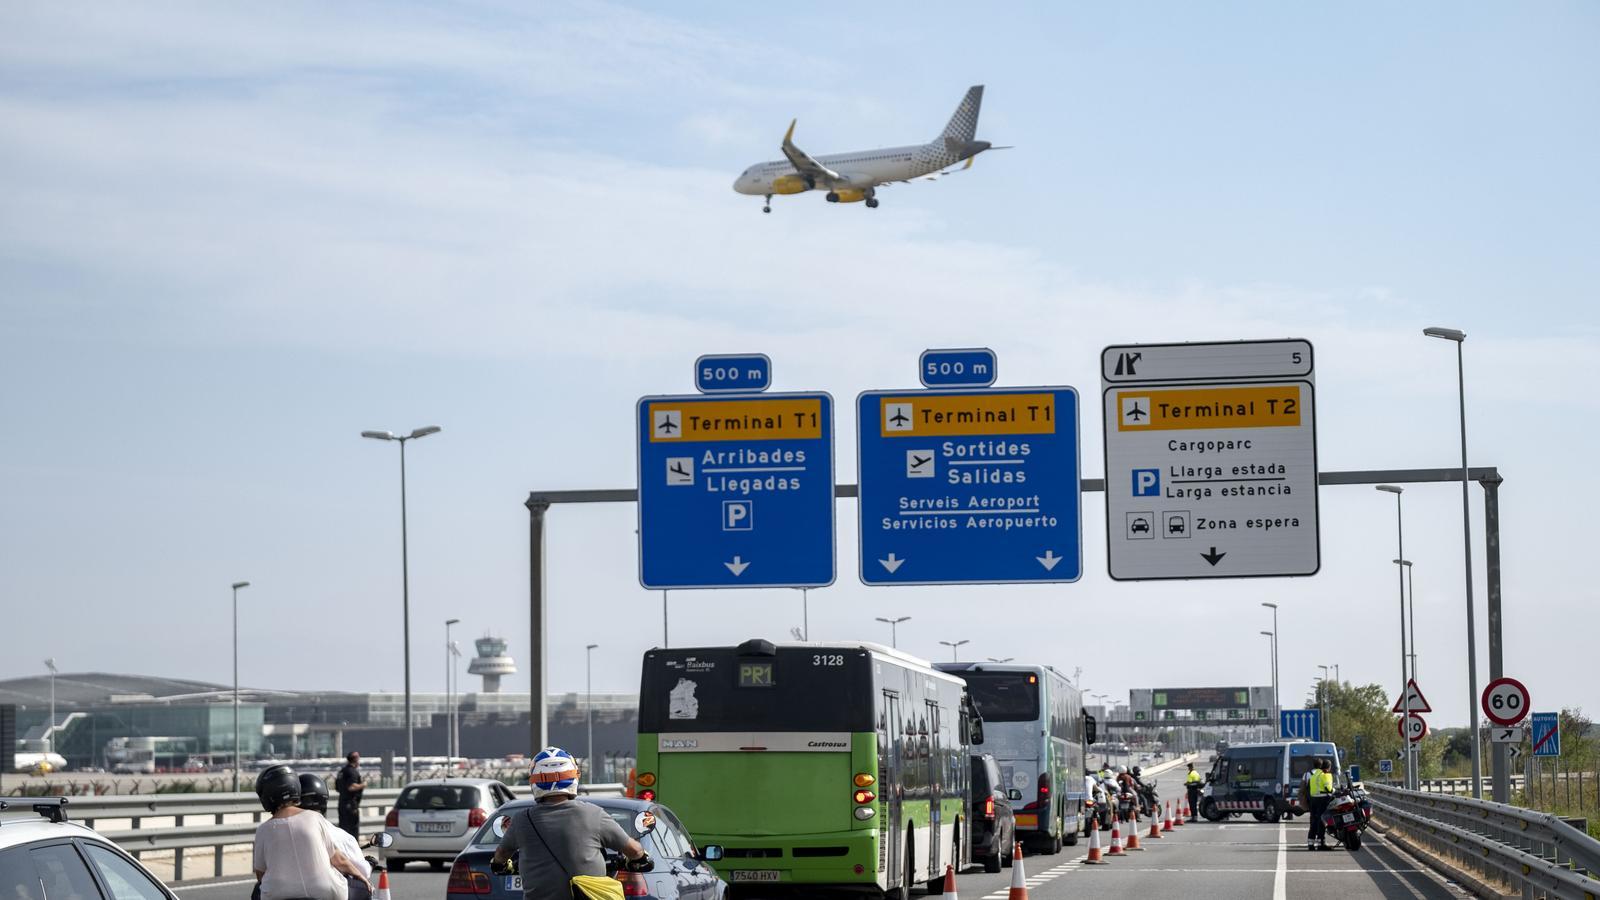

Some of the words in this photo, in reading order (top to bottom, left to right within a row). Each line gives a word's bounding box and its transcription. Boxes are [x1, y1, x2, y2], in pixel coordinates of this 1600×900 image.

[1292, 352, 1302, 364] 5
[703, 367, 739, 381] 500
[748, 368, 762, 380] m
[927, 362, 964, 375] 500
[973, 363, 987, 374] m
[921, 407, 1016, 424] Terminal
[1027, 405, 1051, 422] T1
[1159, 401, 1255, 418] Terminal
[1267, 399, 1297, 415] T2
[690, 414, 783, 431] Terminal
[794, 412, 817, 428] T1
[942, 441, 1031, 457] Sortides
[1168, 438, 1252, 453] Cargoparc
[702, 449, 806, 465] Arribades
[948, 468, 1026, 484] Salidas
[1170, 465, 1222, 479] Llarga
[1232, 463, 1286, 476] estada
[707, 475, 801, 495] Llegadas
[1137, 471, 1156, 495] P
[1166, 486, 1212, 500] Larga
[1221, 483, 1291, 497] estancia
[899, 496, 959, 509] Serveis
[968, 495, 1040, 510] Aeroport
[728, 504, 747, 527] P
[882, 517, 958, 530] Servicios
[966, 515, 1057, 531] Aeropuerto
[1197, 517, 1237, 530] Zona
[1246, 517, 1300, 531] espera
[812, 654, 844, 666] 3128
[741, 665, 772, 684] PR1
[1492, 693, 1520, 710] 60
[662, 740, 697, 748] MAN
[808, 740, 847, 748] Castrosua
[735, 871, 759, 881] 7540
